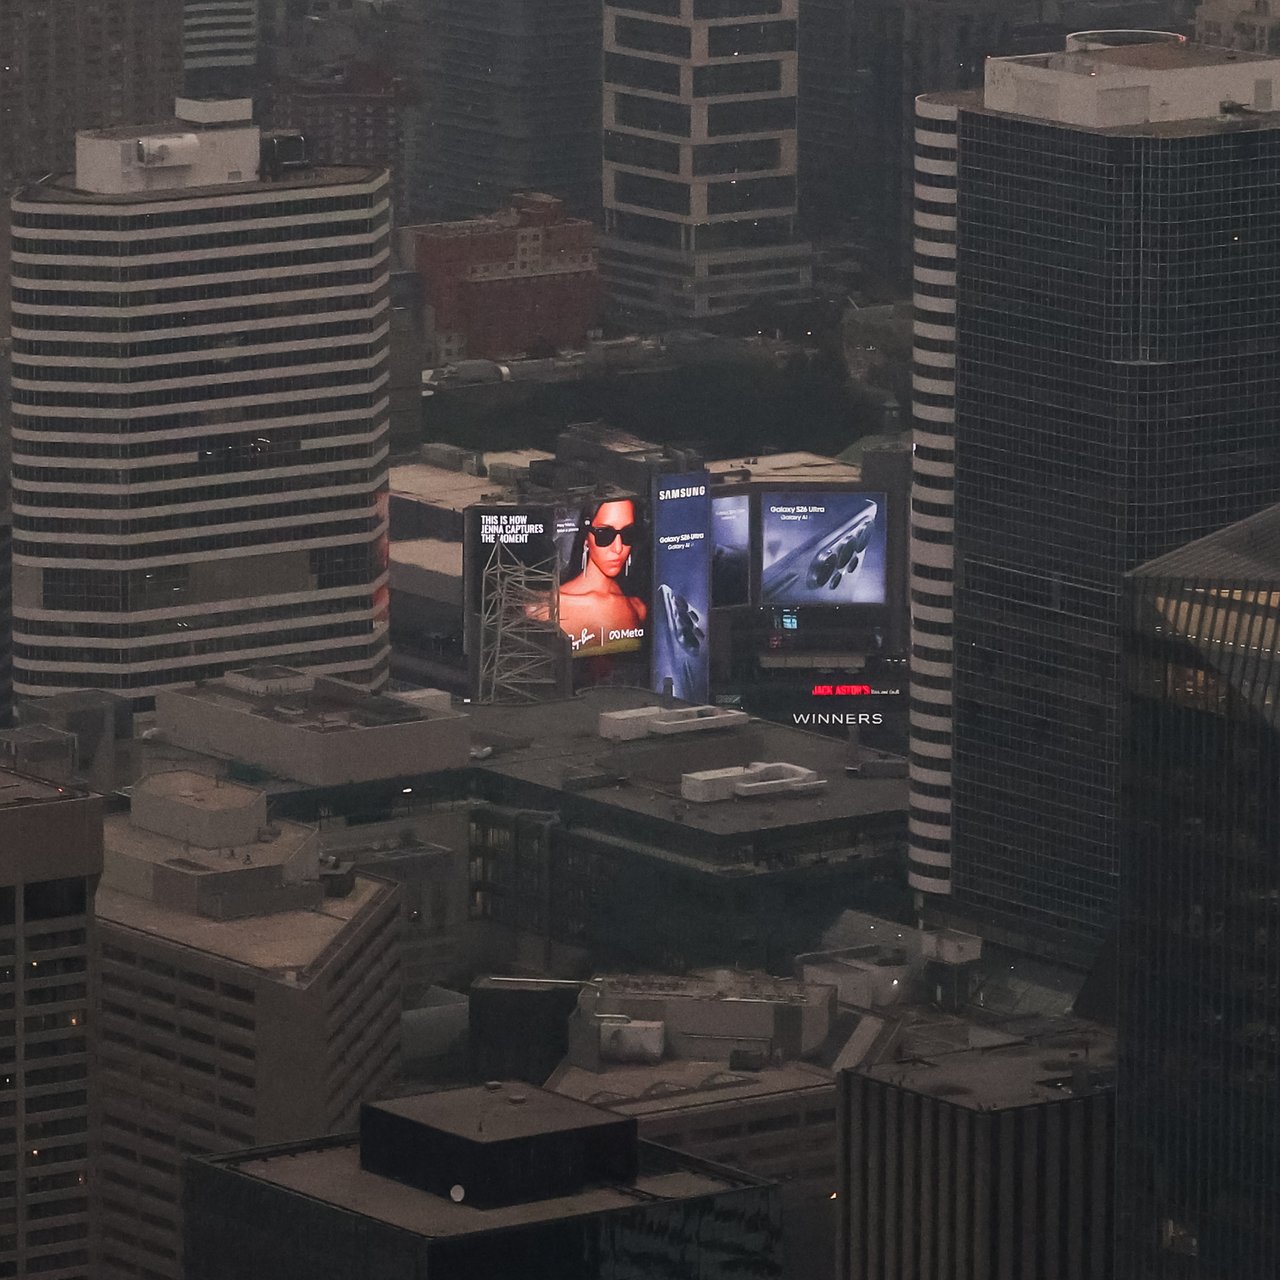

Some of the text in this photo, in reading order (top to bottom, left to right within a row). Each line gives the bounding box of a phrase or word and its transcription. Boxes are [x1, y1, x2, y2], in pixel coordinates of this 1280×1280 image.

[659, 486, 705, 500] SAMSUNG
[481, 516, 527, 524] THIS IS HOW
[481, 524, 543, 533] JENNA CAPTURES
[481, 534, 495, 543] THE
[659, 535, 680, 543] Galaxy
[621, 628, 644, 638] Meta
[812, 685, 833, 695] JACK
[793, 713, 883, 724] WINNERS
